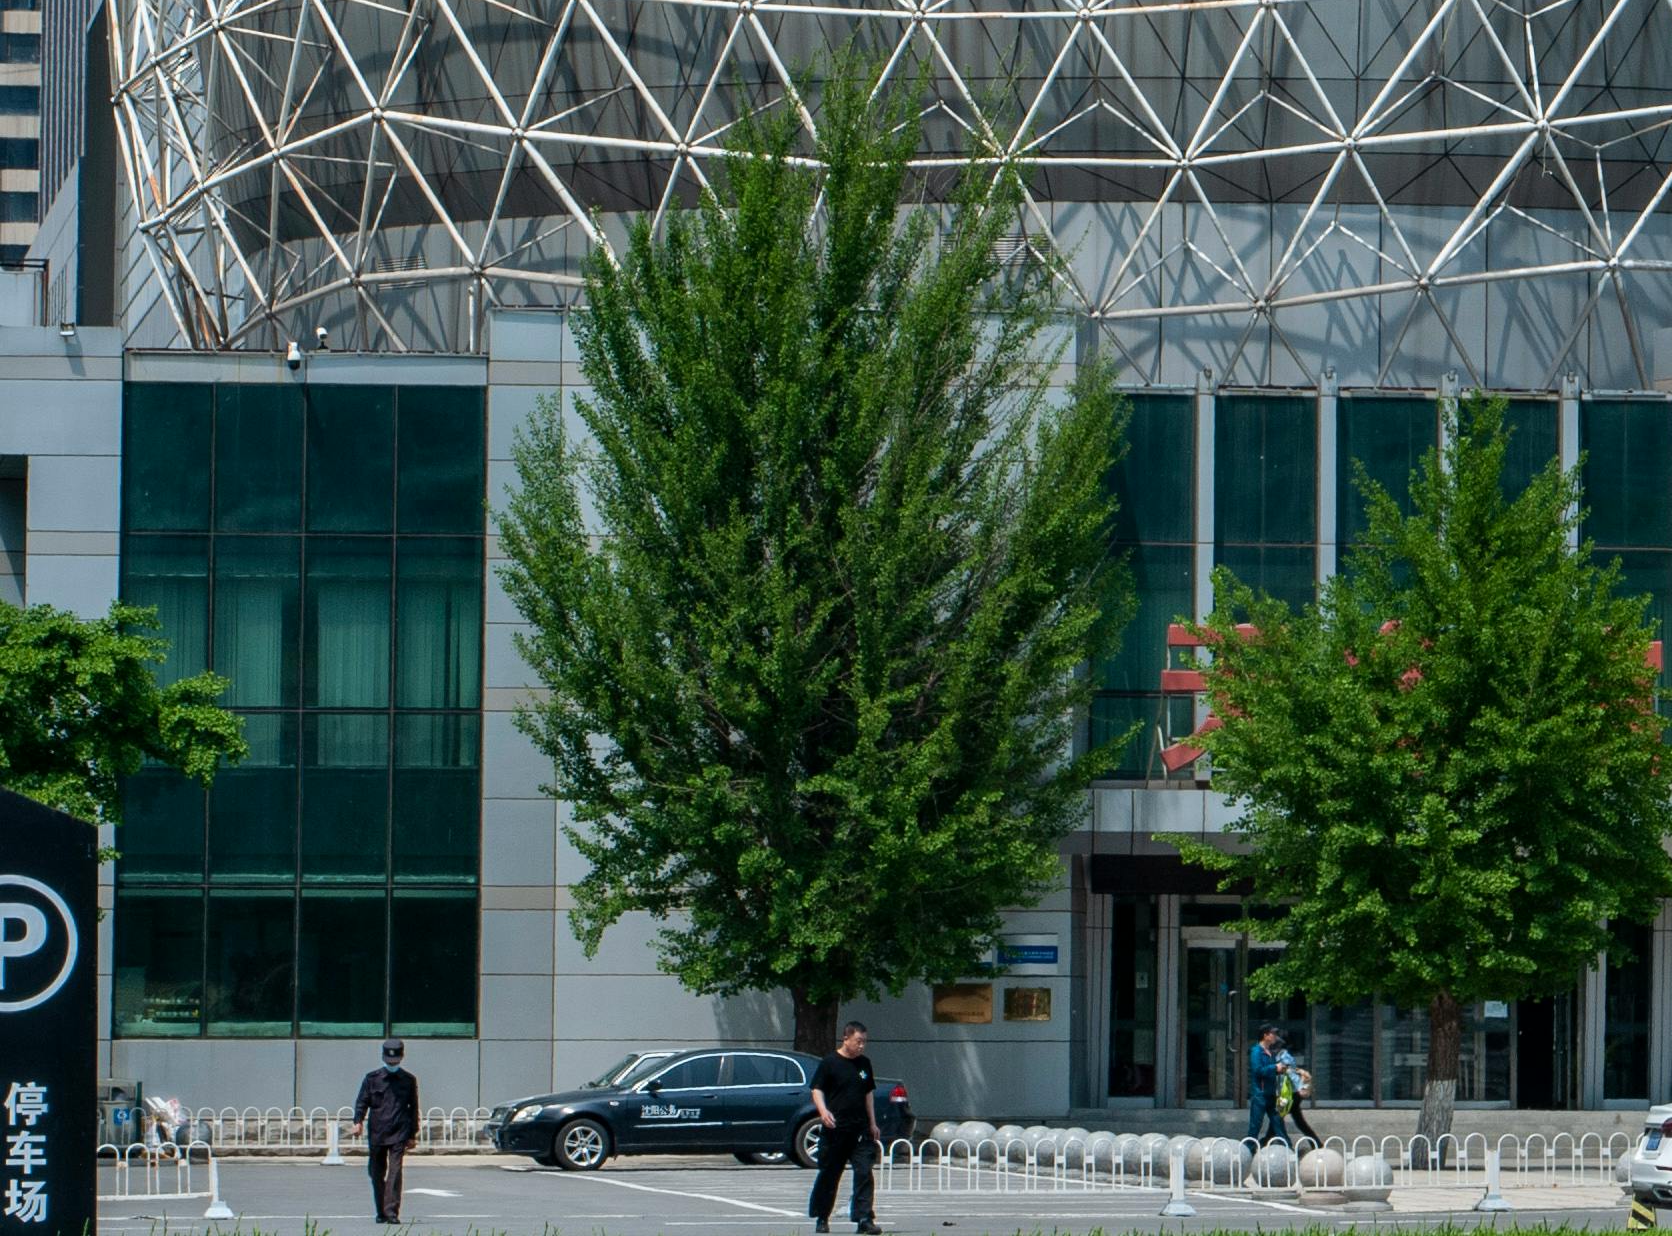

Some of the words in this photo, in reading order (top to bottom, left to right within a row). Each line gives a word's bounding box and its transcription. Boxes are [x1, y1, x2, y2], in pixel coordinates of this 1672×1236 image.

[0, 903, 47, 990] P
[4, 1082, 49, 1223] 停车场
